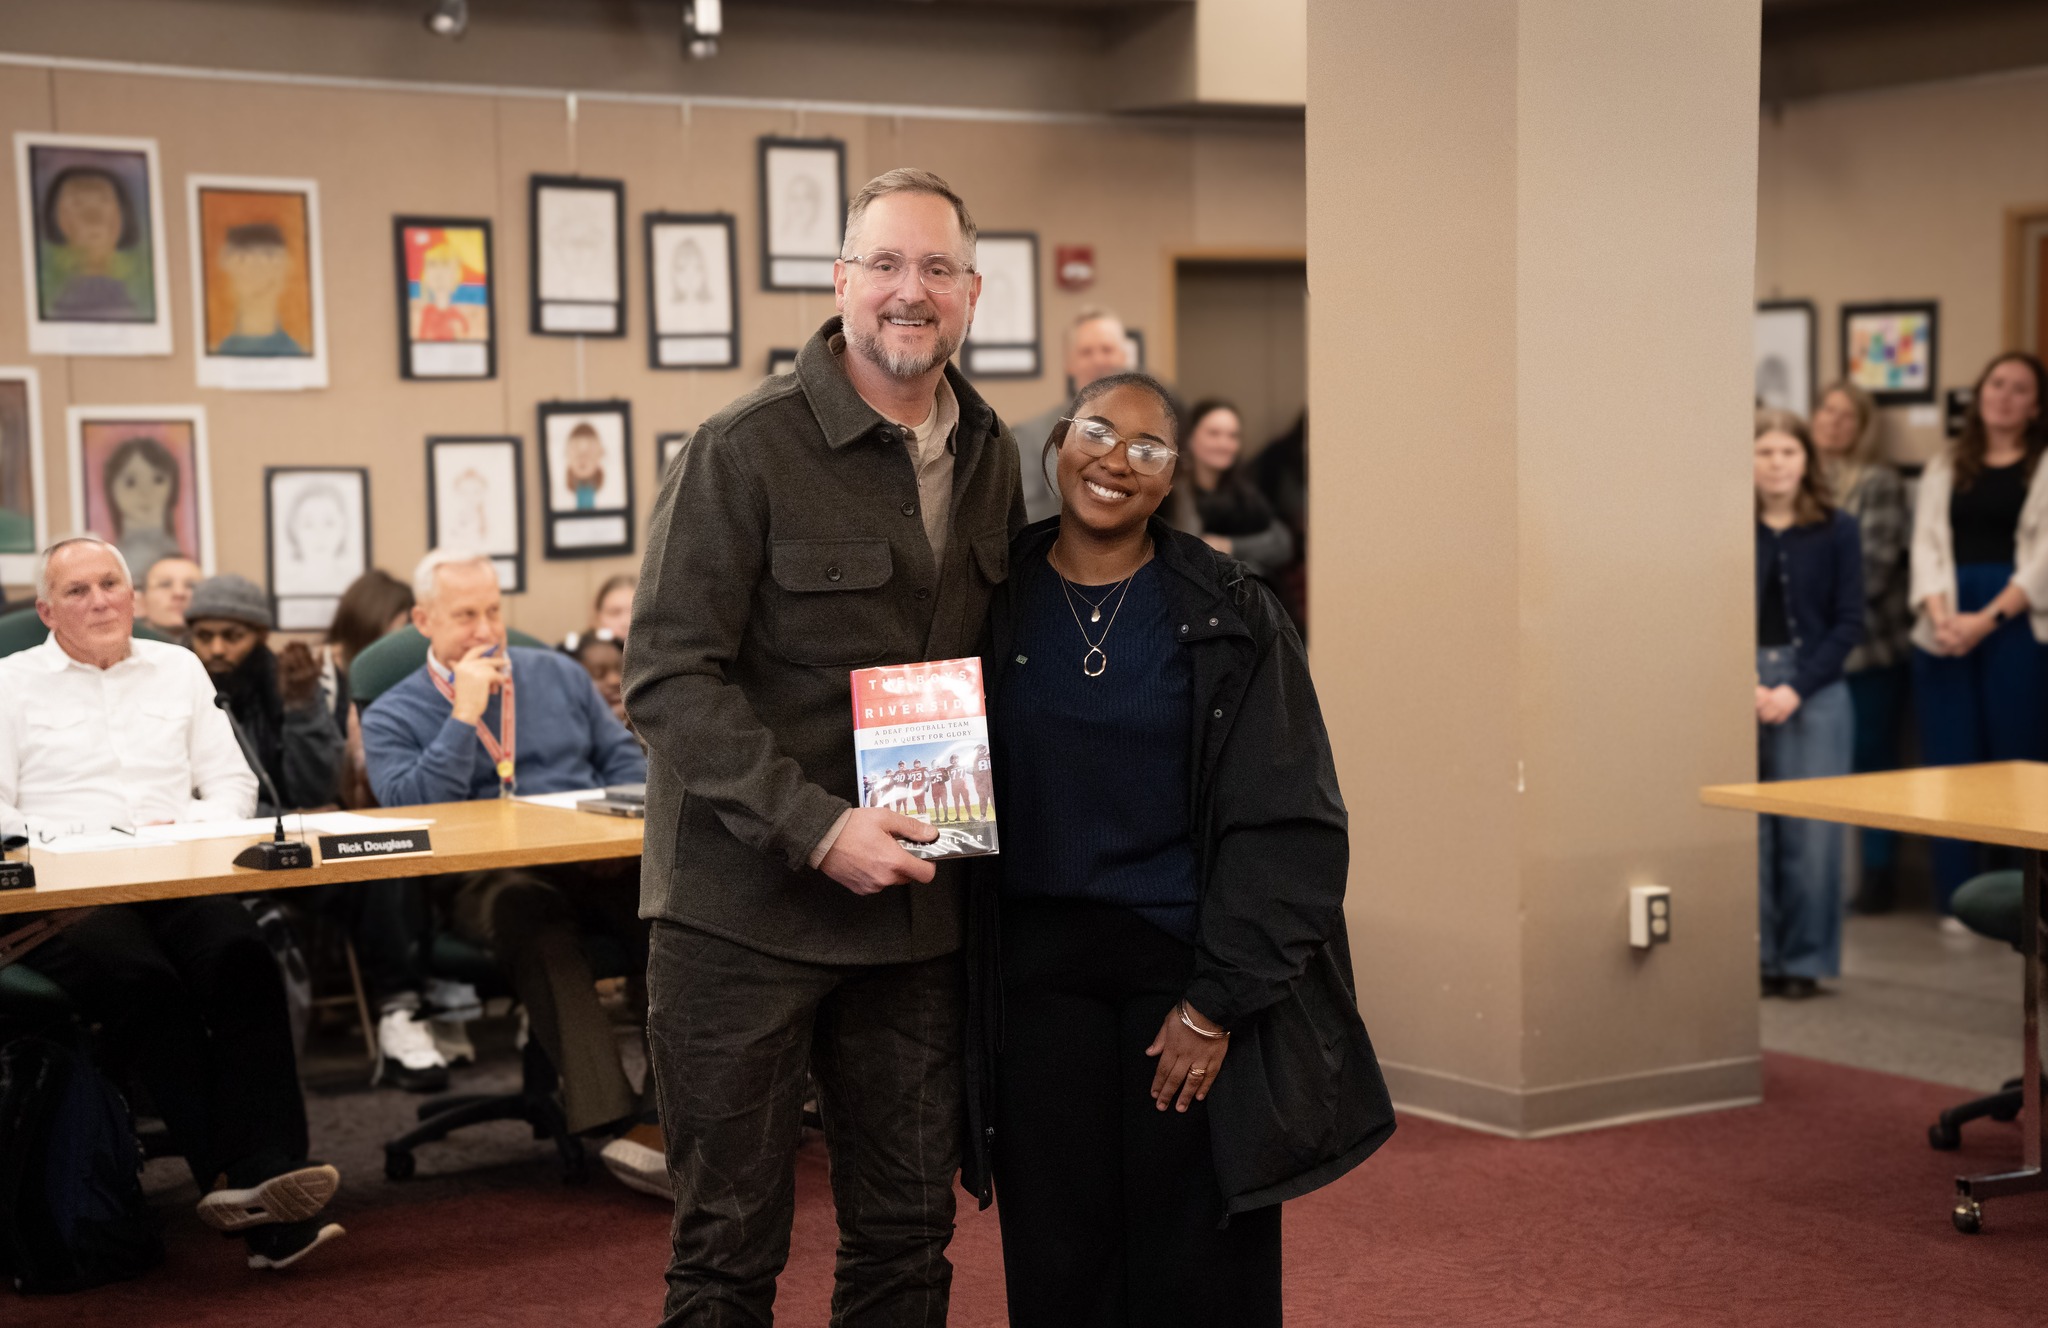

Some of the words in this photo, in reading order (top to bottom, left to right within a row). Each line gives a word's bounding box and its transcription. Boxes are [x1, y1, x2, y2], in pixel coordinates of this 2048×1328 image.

[868, 677, 905, 690] THE
[916, 670, 967, 686] BOYS
[865, 699, 967, 719] RIVERSID
[882, 727, 902, 735] DEAF
[905, 723, 945, 733] FOOTBALL
[948, 721, 969, 729] TEAM
[900, 735, 925, 744] QUEST
[946, 730, 972, 738] GLORY
[337, 842, 363, 854] Rick
[363, 839, 414, 852] Douglass
